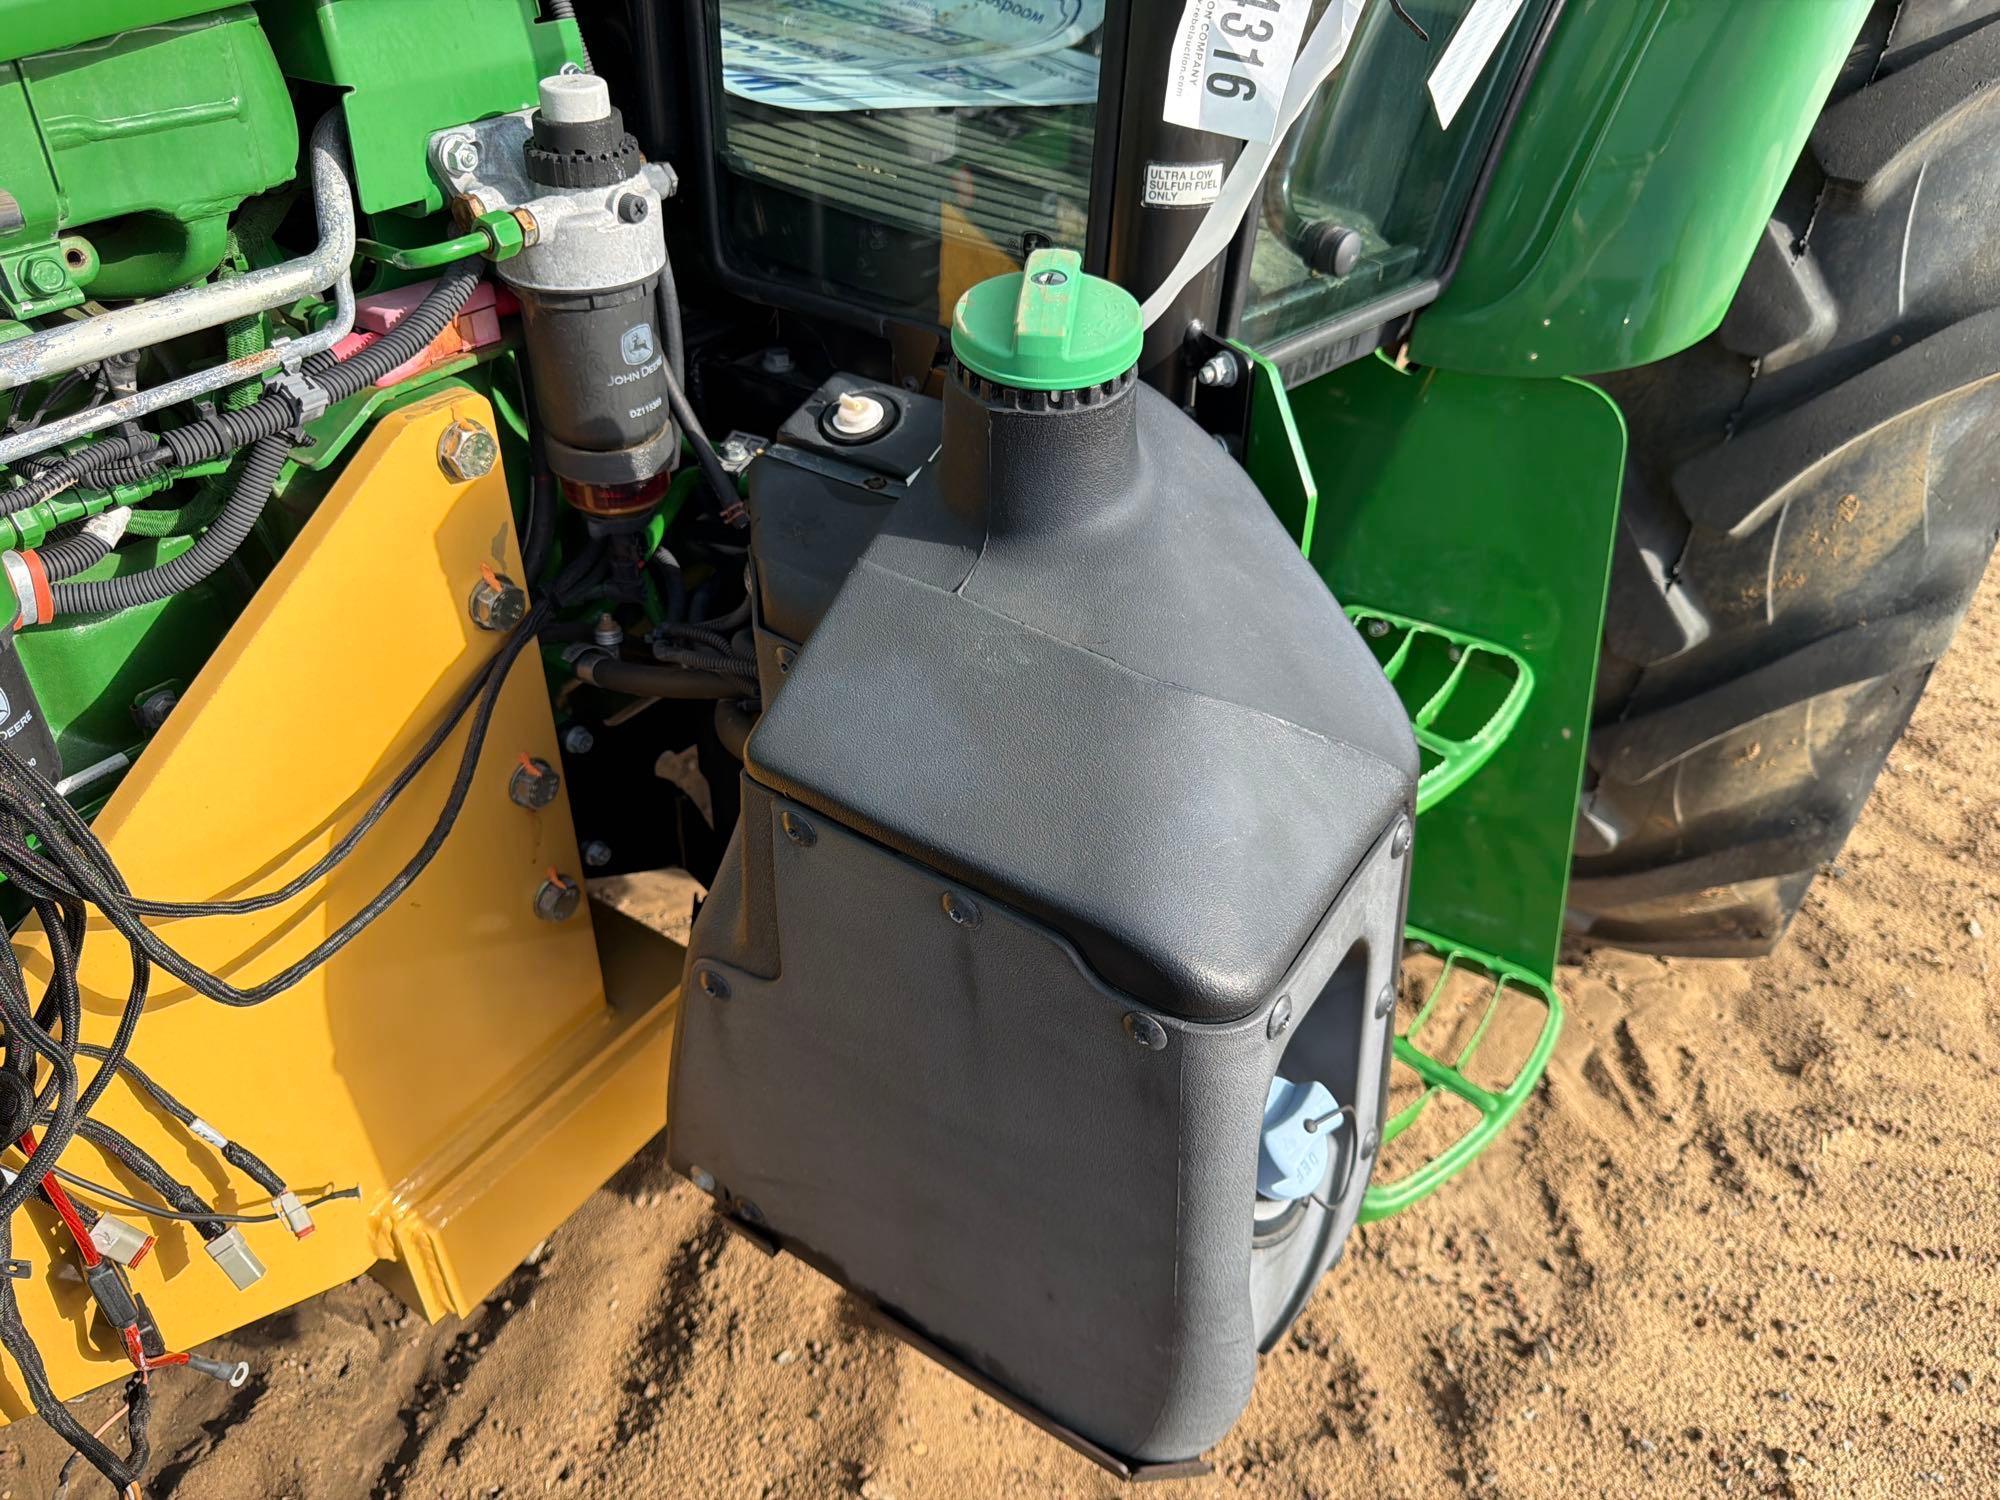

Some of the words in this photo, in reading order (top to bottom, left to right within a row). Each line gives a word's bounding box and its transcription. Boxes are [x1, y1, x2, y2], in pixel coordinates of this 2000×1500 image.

[1190, 24, 1210, 86] COMPANY
[1150, 169, 1187, 181] ULTRA
[1190, 170, 1213, 181] LOW
[1149, 180, 1192, 191] SULFUR
[1194, 179, 1218, 191] FUEL
[1148, 190, 1178, 201] ONLY
[607, 371, 640, 387] JOHN
